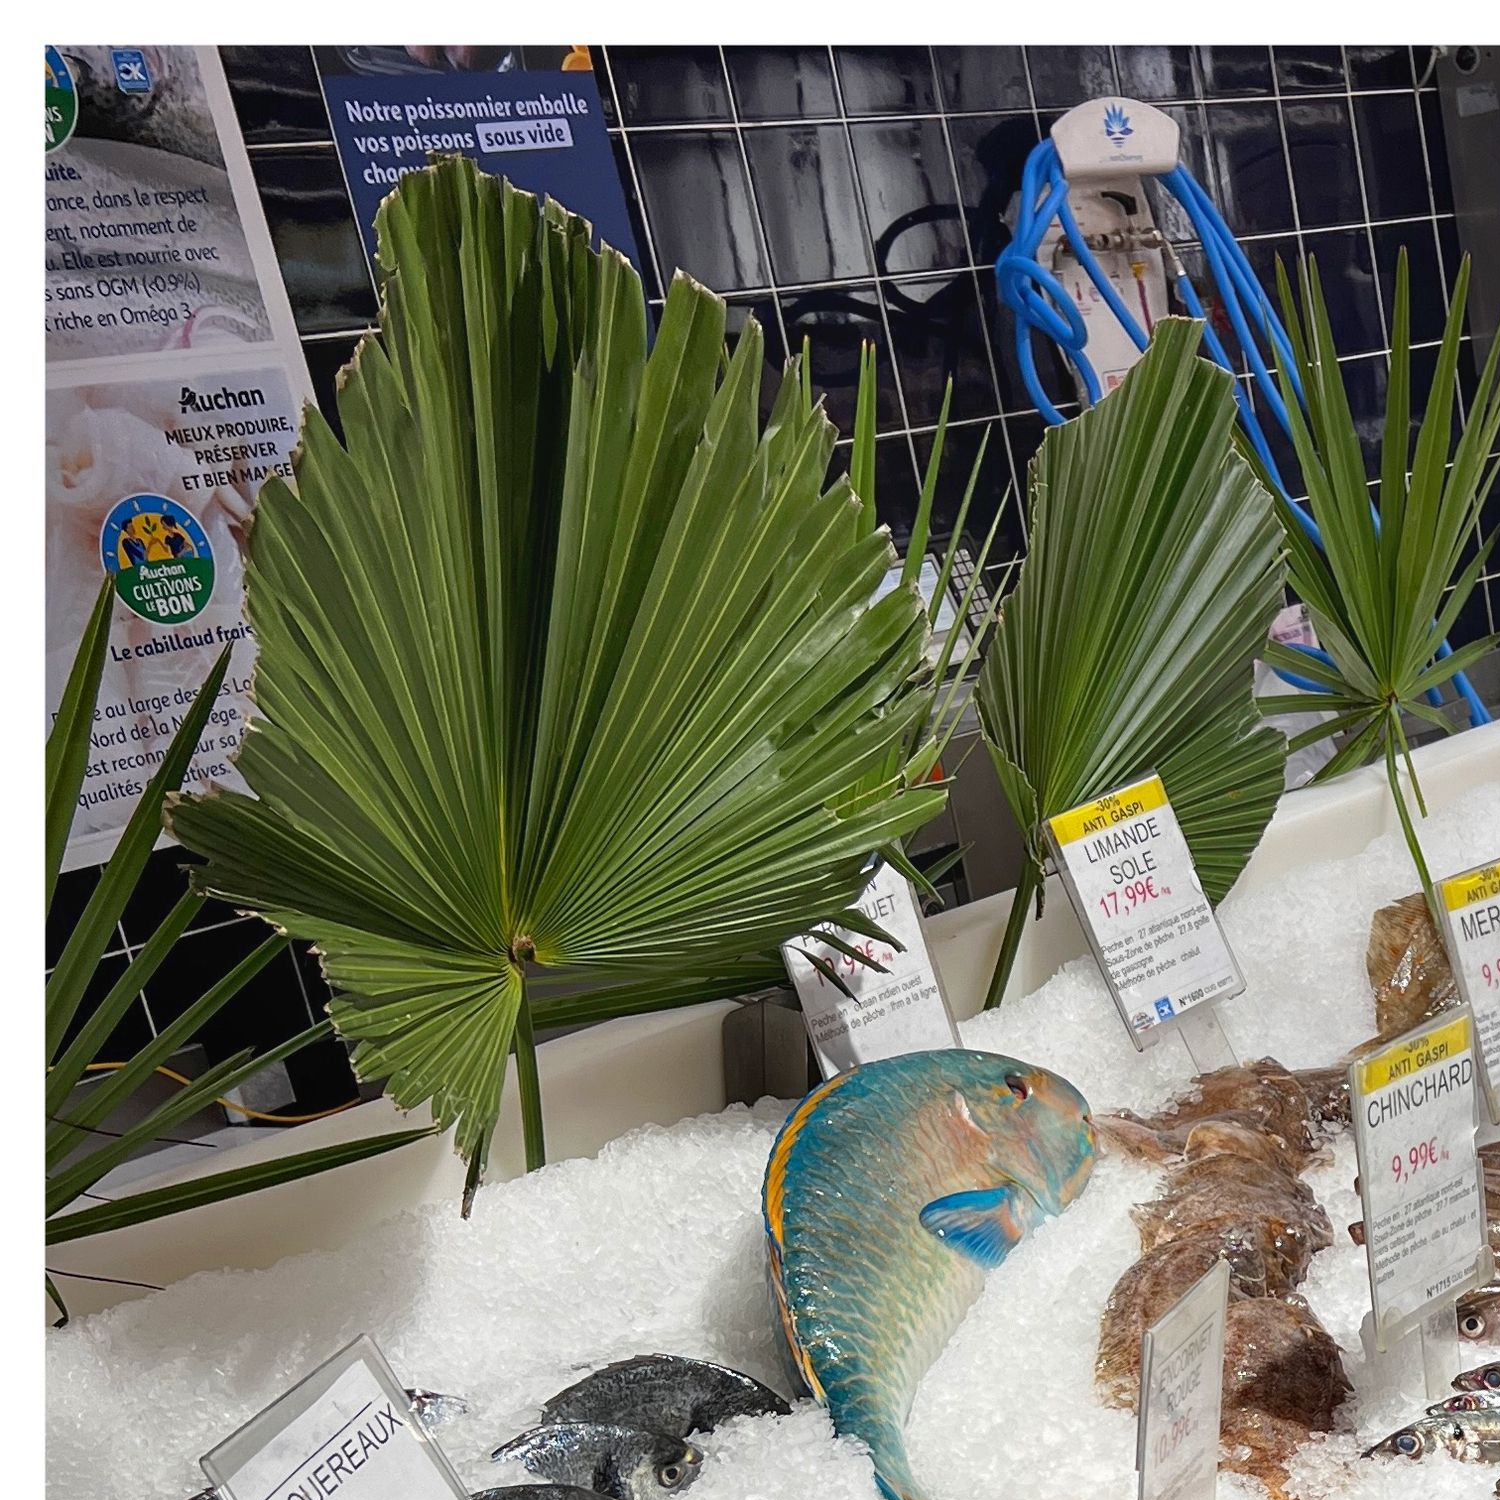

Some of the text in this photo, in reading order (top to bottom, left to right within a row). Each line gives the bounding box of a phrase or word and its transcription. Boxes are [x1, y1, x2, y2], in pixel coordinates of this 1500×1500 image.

[345, 93, 588, 126] Notre poissonnier emballe
[354, 122, 566, 157] vos poissons sous vide
[93, 189, 132, 208] dans
[135, 188, 150, 207] le
[154, 188, 208, 208] respect
[81, 219, 172, 240] notamment
[178, 216, 197, 233] de
[62, 251, 95, 271] Elle
[100, 250, 123, 269] est
[126, 246, 180, 267] nourrie
[185, 245, 219, 261] avec
[56, 284, 95, 300] sans
[97, 277, 139, 297] OGM
[54, 310, 94, 331] riche
[100, 311, 118, 327] en
[120, 303, 178, 328] Oméga
[179, 386, 265, 414] Auchan
[165, 416, 294, 446] MIEUX PRODUIRE,
[195, 441, 279, 466] PRÉSERVER
[182, 475, 201, 491] ET
[204, 470, 239, 488] BIEN
[139, 564, 186, 581] Auchan
[145, 594, 196, 617] LE BON
[111, 645, 132, 662] Le
[135, 629, 214, 656] cabillaud
[105, 704, 127, 719] au
[129, 695, 171, 715] large
[130, 724, 151, 742] de
[149, 716, 170, 736] la
[220, 734, 237, 750] sa
[78, 779, 143, 811] qualités
[1082, 801, 1144, 834] ANTI GASPI
[1084, 817, 1161, 864] LIMANDE
[1110, 851, 1156, 885] SOLE
[1100, 876, 1160, 918] 17,99€
[1467, 887, 1487, 903] ANTI
[1389, 1042, 1449, 1080] ANTI GASPI
[1367, 1058, 1473, 1128] CHINCHARD
[1392, 1136, 1438, 1184] 9,99€
[1160, 1322, 1214, 1393] ENCORNET
[1167, 1363, 1202, 1413] ROUGE
[1154, 1407, 1192, 1469] 10.99€
